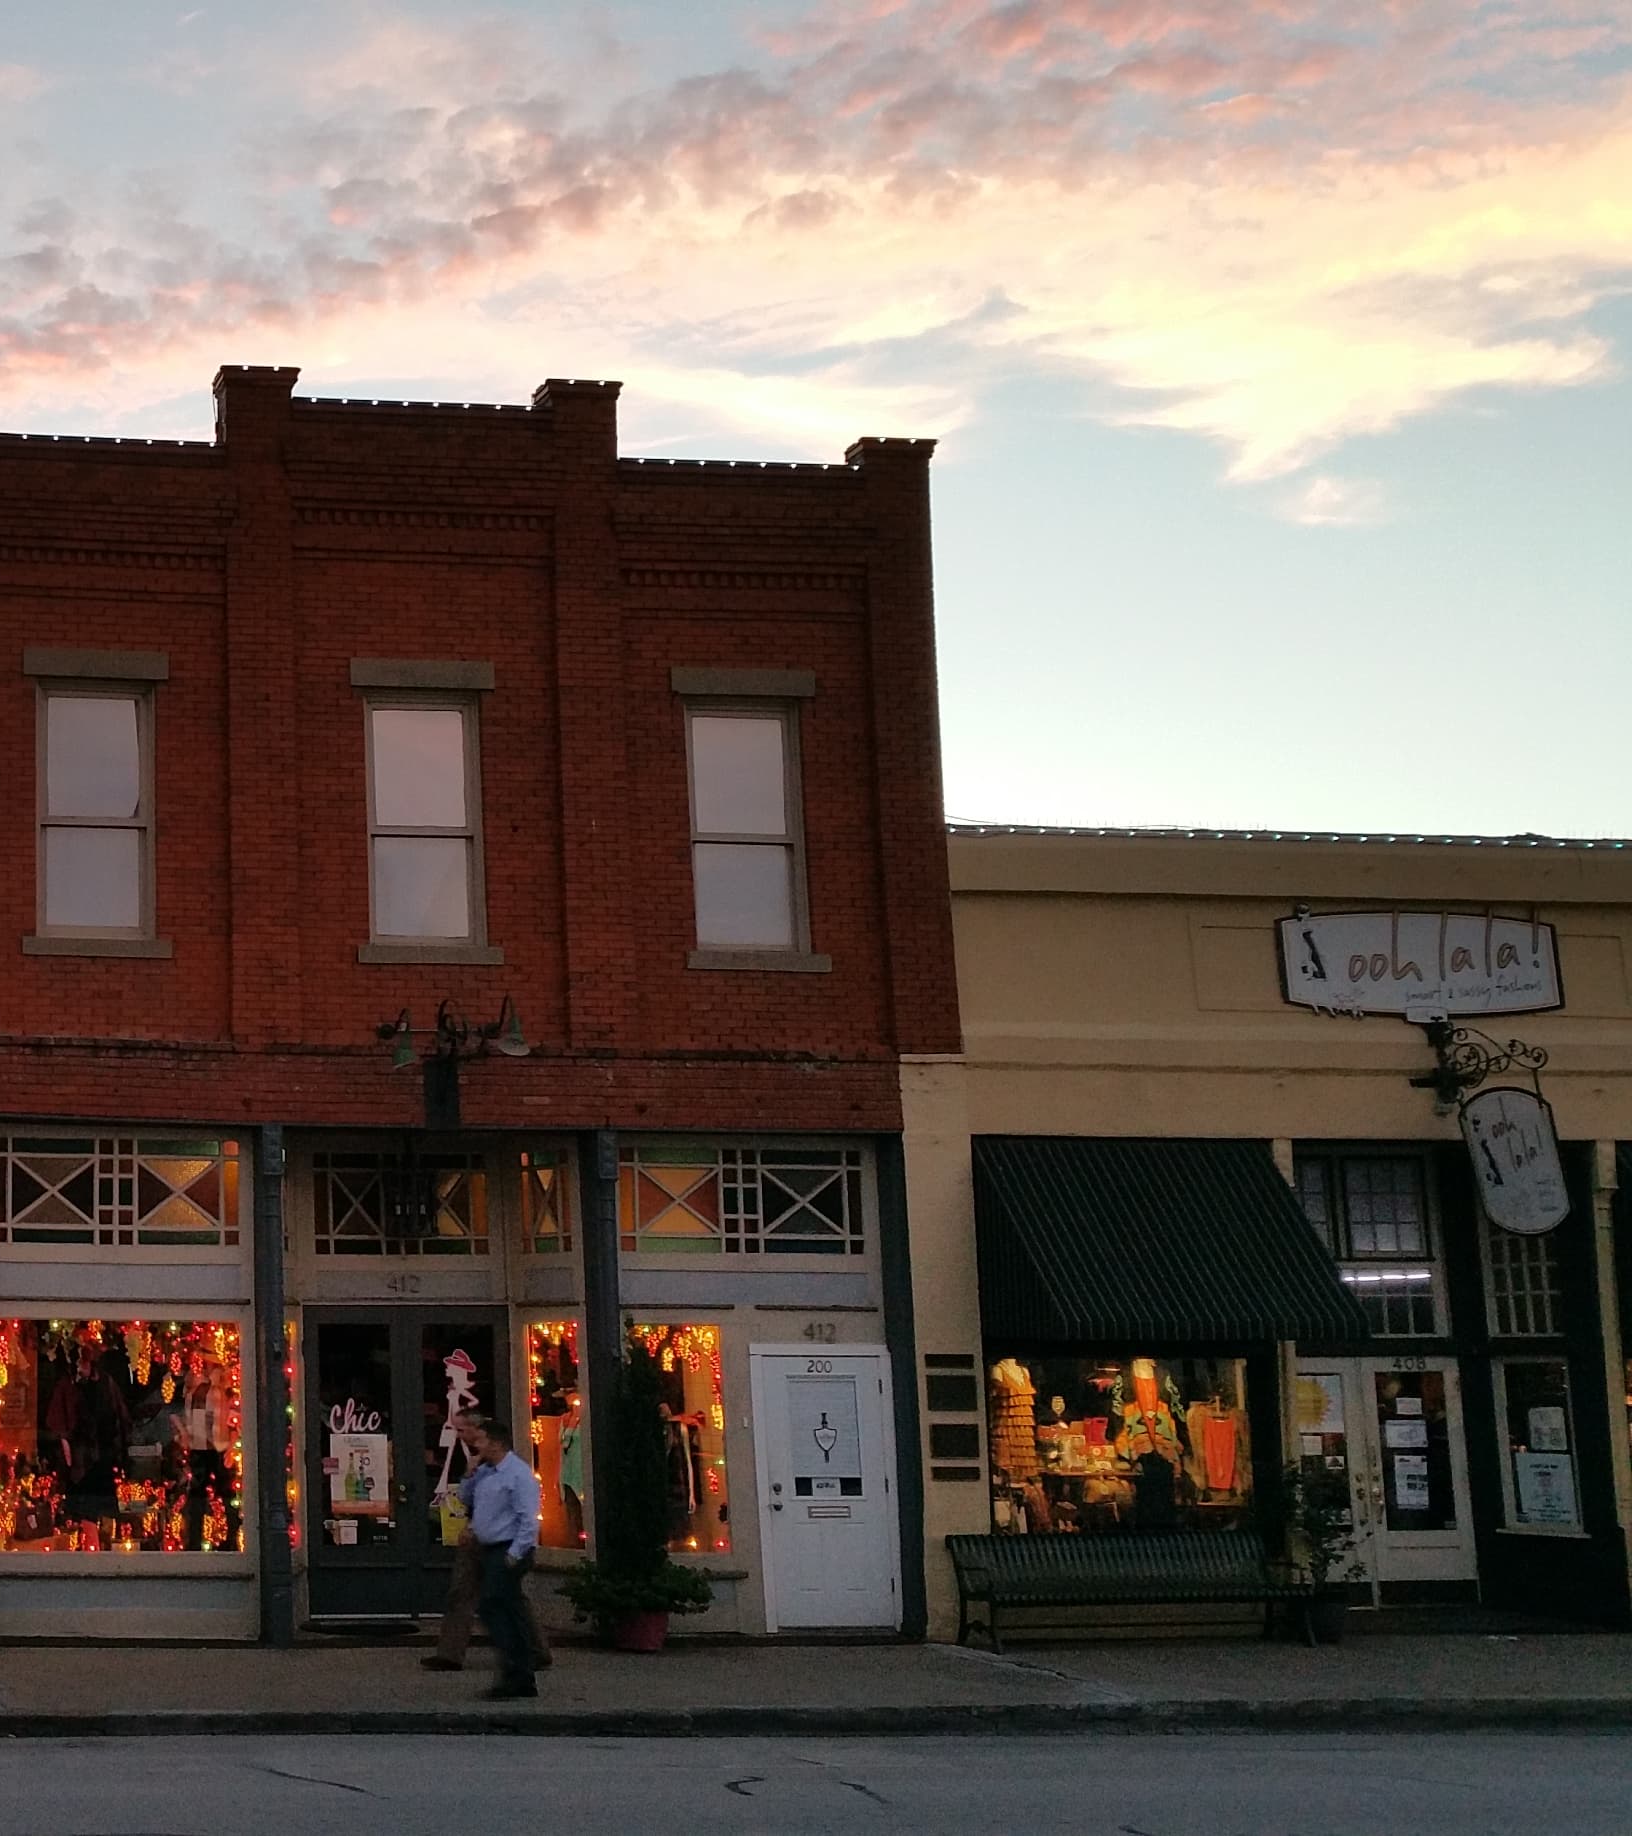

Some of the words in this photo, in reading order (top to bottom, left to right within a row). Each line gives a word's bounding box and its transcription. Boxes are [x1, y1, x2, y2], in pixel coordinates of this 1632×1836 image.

[1348, 907, 1423, 982] ooh
[387, 1274, 420, 1293] 412
[803, 1323, 836, 1344] 412
[807, 1360, 833, 1373] 200
[329, 1397, 381, 1433] Chic
